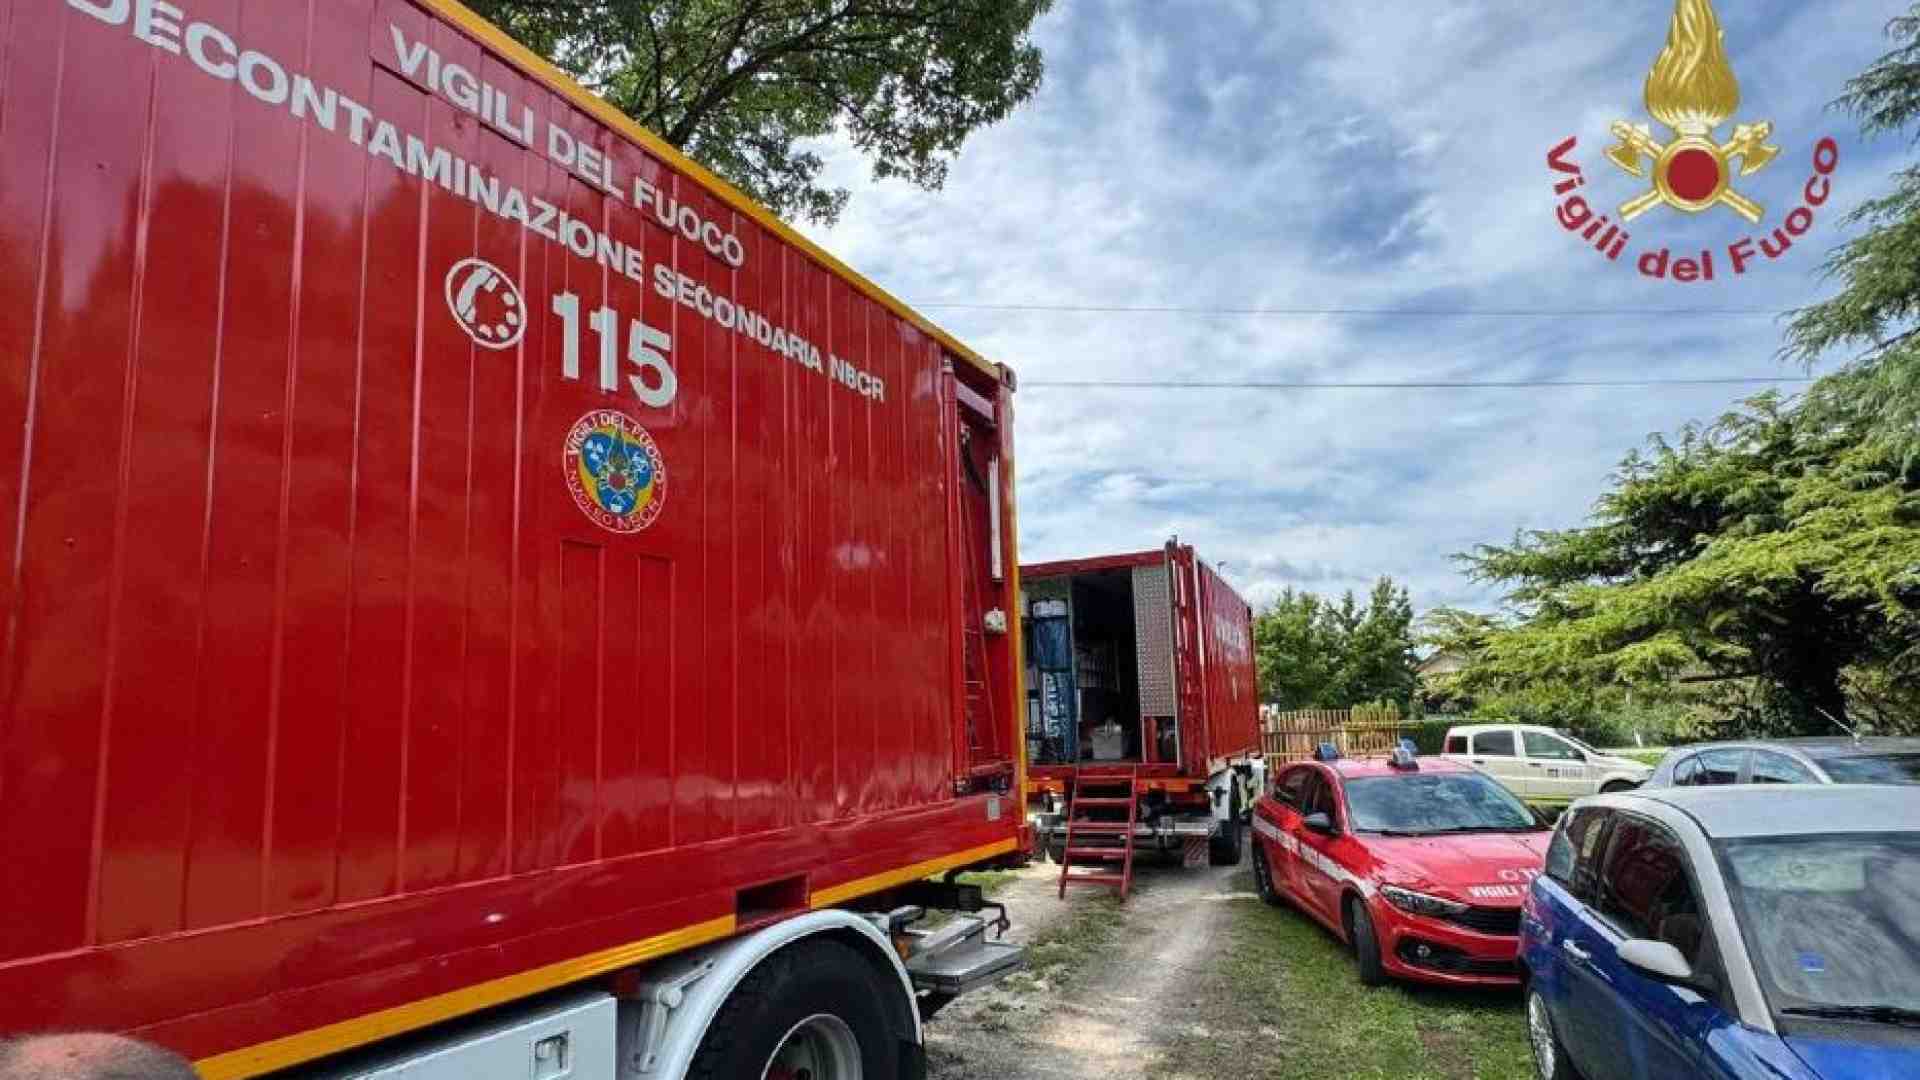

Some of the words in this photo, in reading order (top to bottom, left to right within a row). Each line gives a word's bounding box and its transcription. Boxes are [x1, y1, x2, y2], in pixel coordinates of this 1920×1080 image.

[391, 25, 534, 145] VIGILI
[548, 121, 624, 200] DEL
[634, 175, 744, 268] FUOCO
[552, 289, 677, 408] 115
[654, 263, 823, 374] SECONDARIA
[830, 353, 885, 403] NBCR
